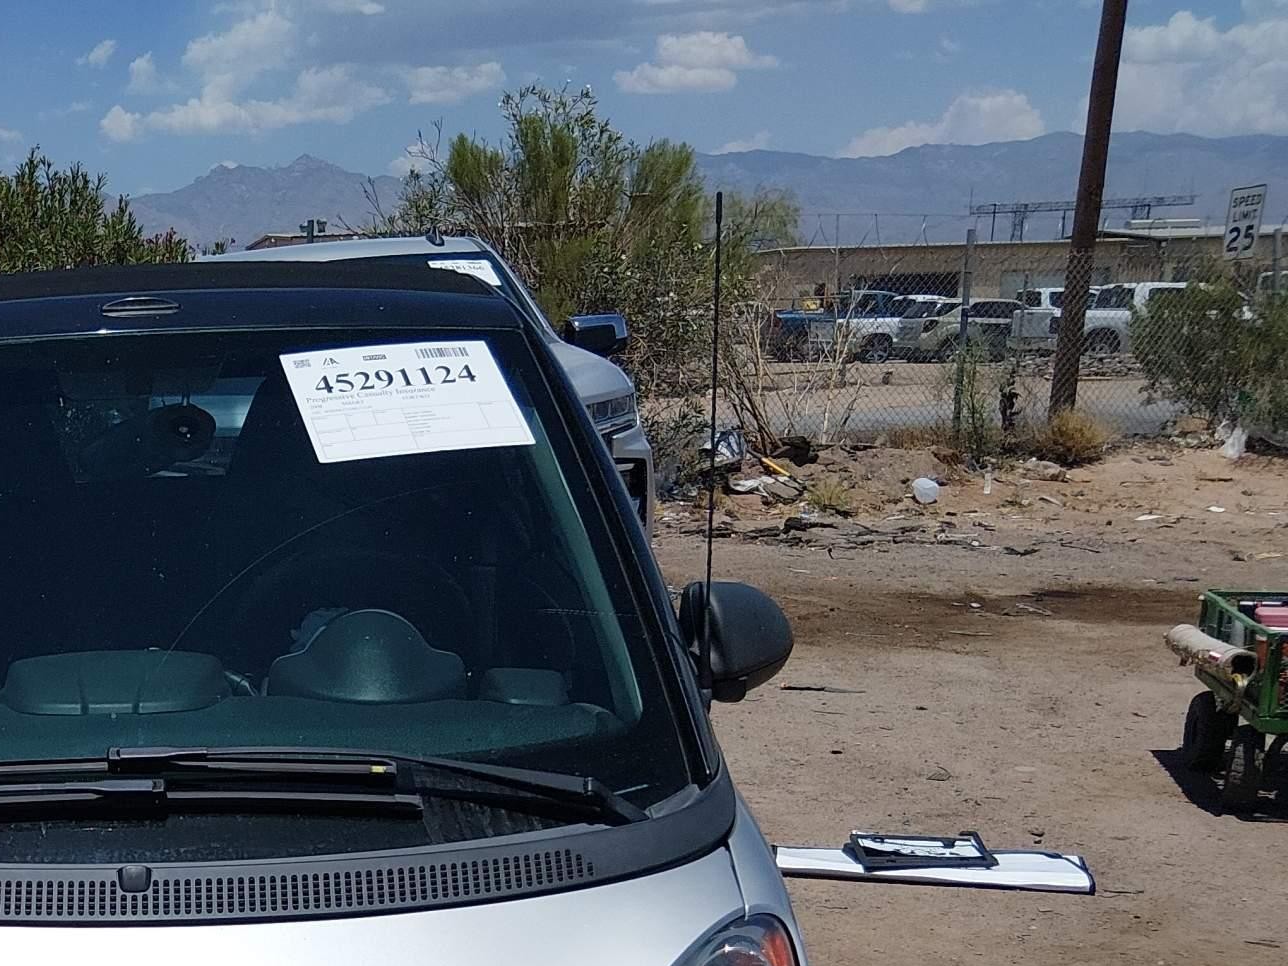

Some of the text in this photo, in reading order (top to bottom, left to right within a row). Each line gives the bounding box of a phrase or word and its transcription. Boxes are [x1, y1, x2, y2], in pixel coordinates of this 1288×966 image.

[1232, 194, 1262, 208] SPEED
[1232, 209, 1258, 222] LIMIT
[1226, 224, 1254, 252] 25
[315, 363, 477, 394] 45291124
[306, 384, 436, 404] Progressive Casualty Insurance
